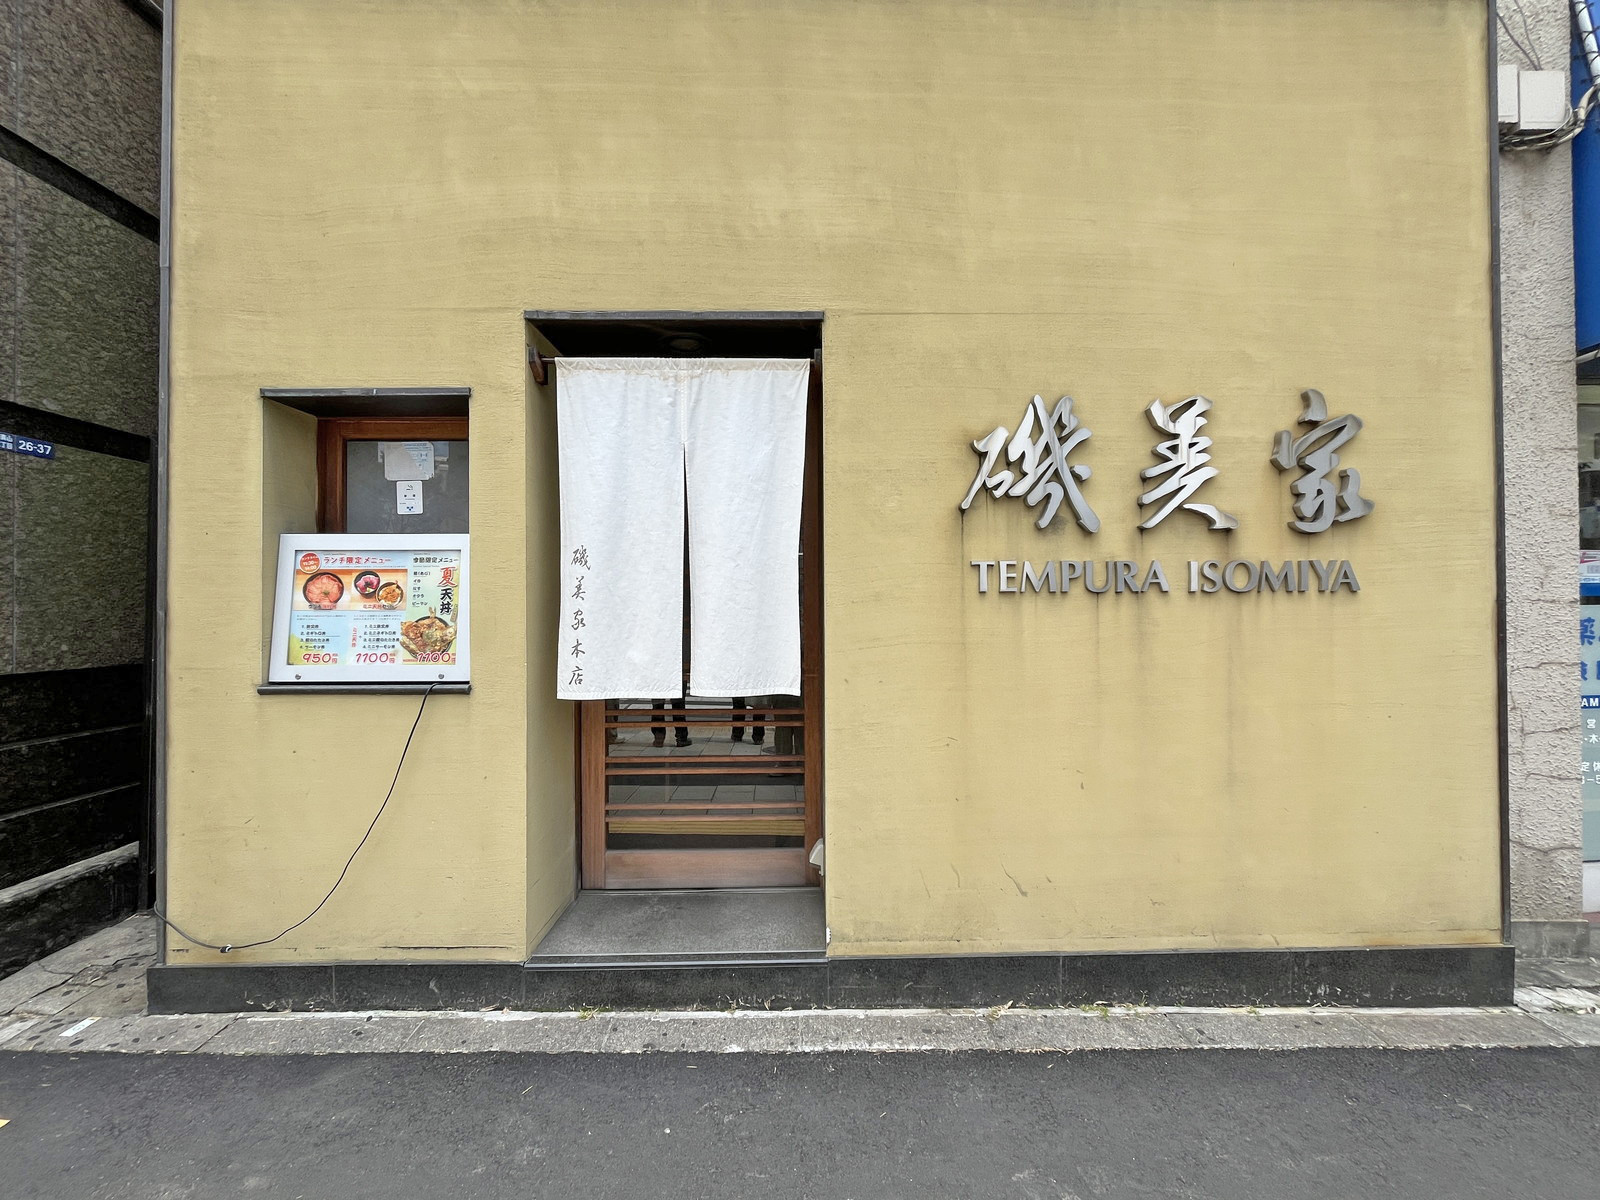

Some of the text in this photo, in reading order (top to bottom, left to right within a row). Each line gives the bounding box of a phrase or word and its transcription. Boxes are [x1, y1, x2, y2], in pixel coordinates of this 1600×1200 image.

[18, 440, 52, 455] 26-37
[959, 388, 1375, 534] 磯美家
[569, 545, 591, 685] 磯美家本店
[970, 559, 1361, 594] TEMPURA ISOMIYA
